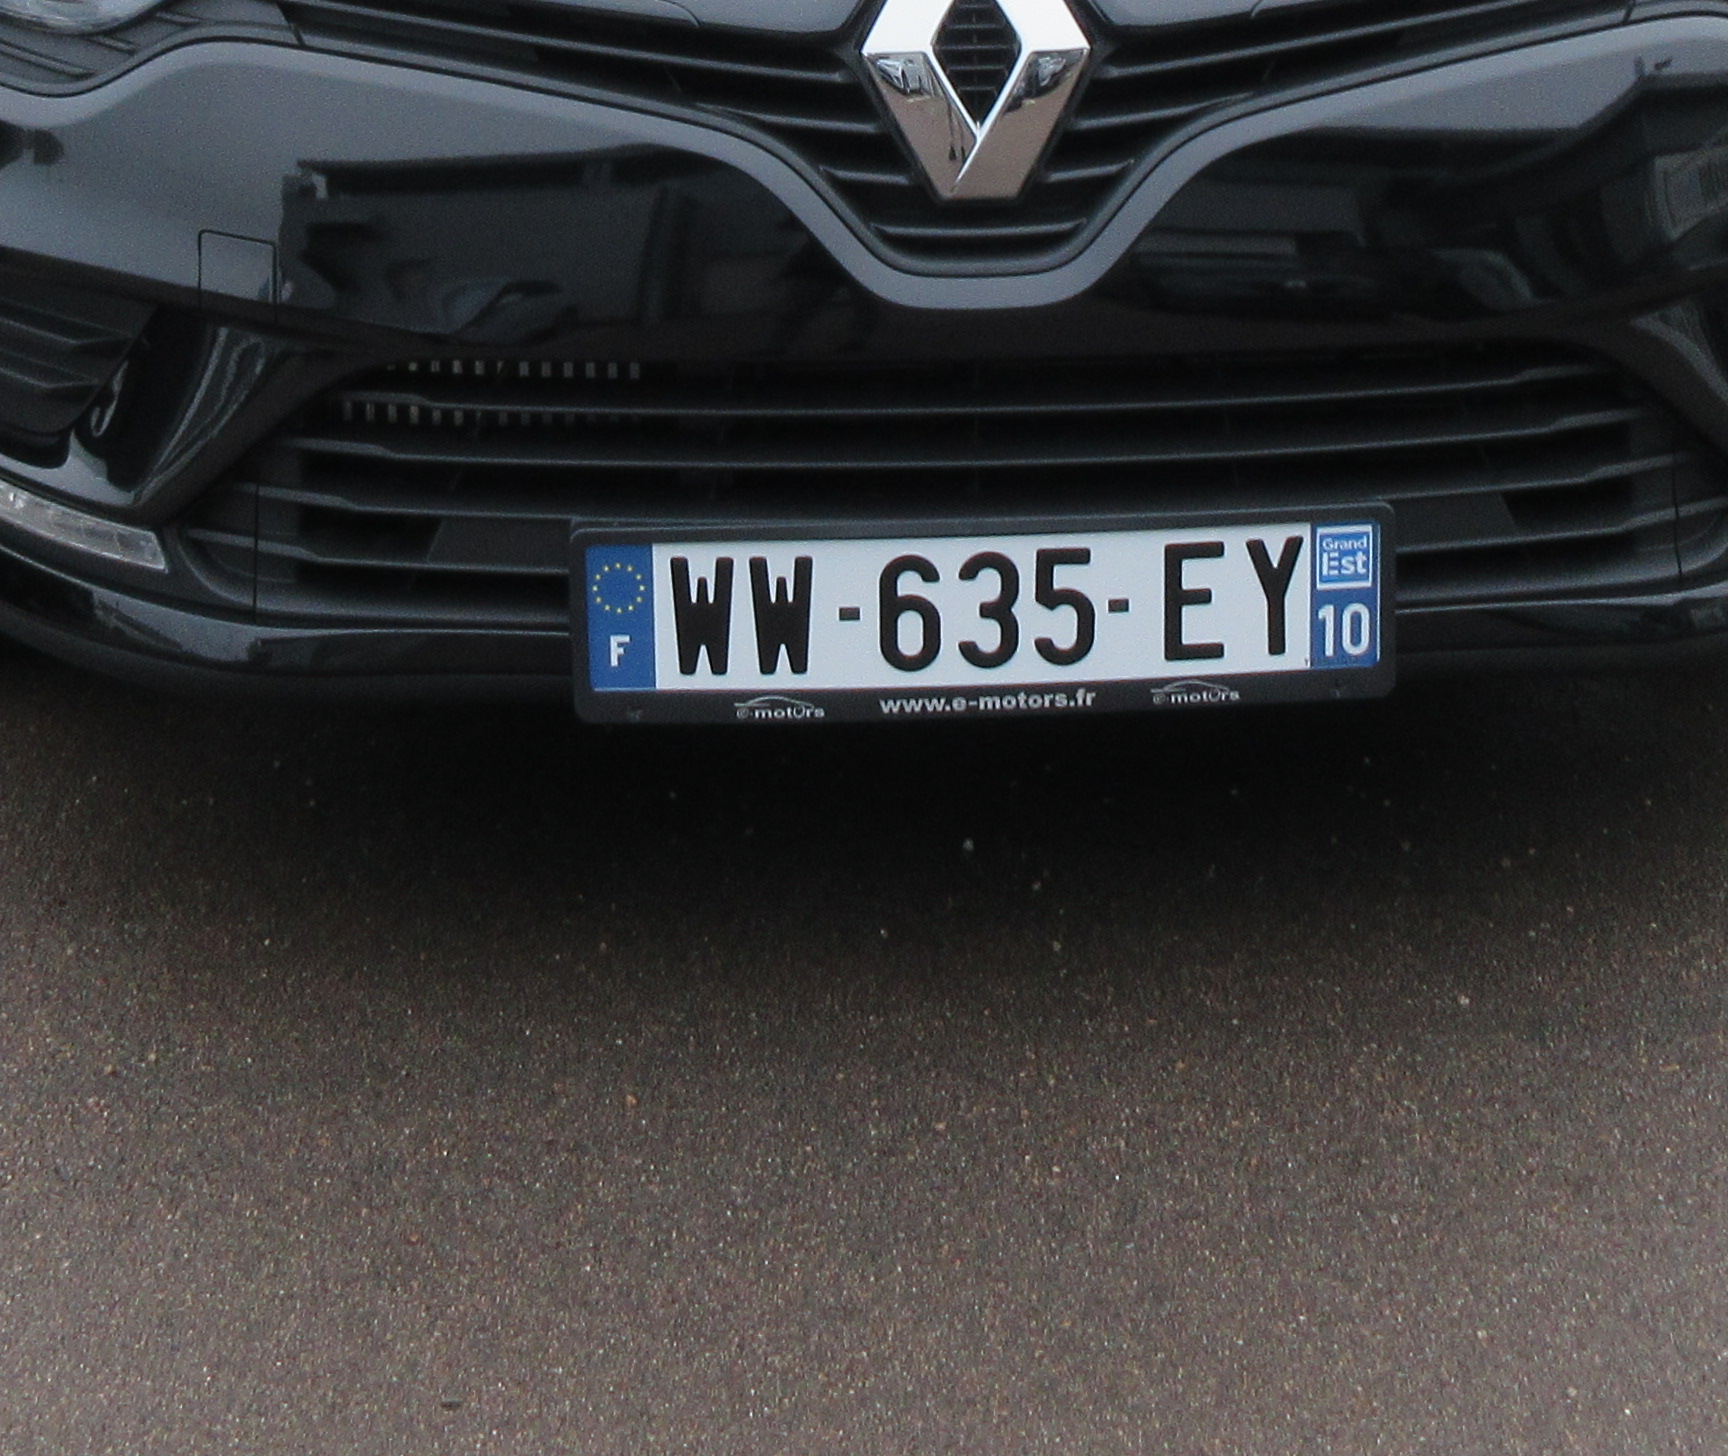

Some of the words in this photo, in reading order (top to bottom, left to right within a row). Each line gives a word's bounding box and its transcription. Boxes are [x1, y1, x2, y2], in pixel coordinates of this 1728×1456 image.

[1322, 535, 1368, 550] Grand
[1322, 551, 1368, 576] Est
[1317, 602, 1370, 657] 10
[609, 634, 631, 668] F
[879, 687, 1096, 715] www.e-motors.fr
